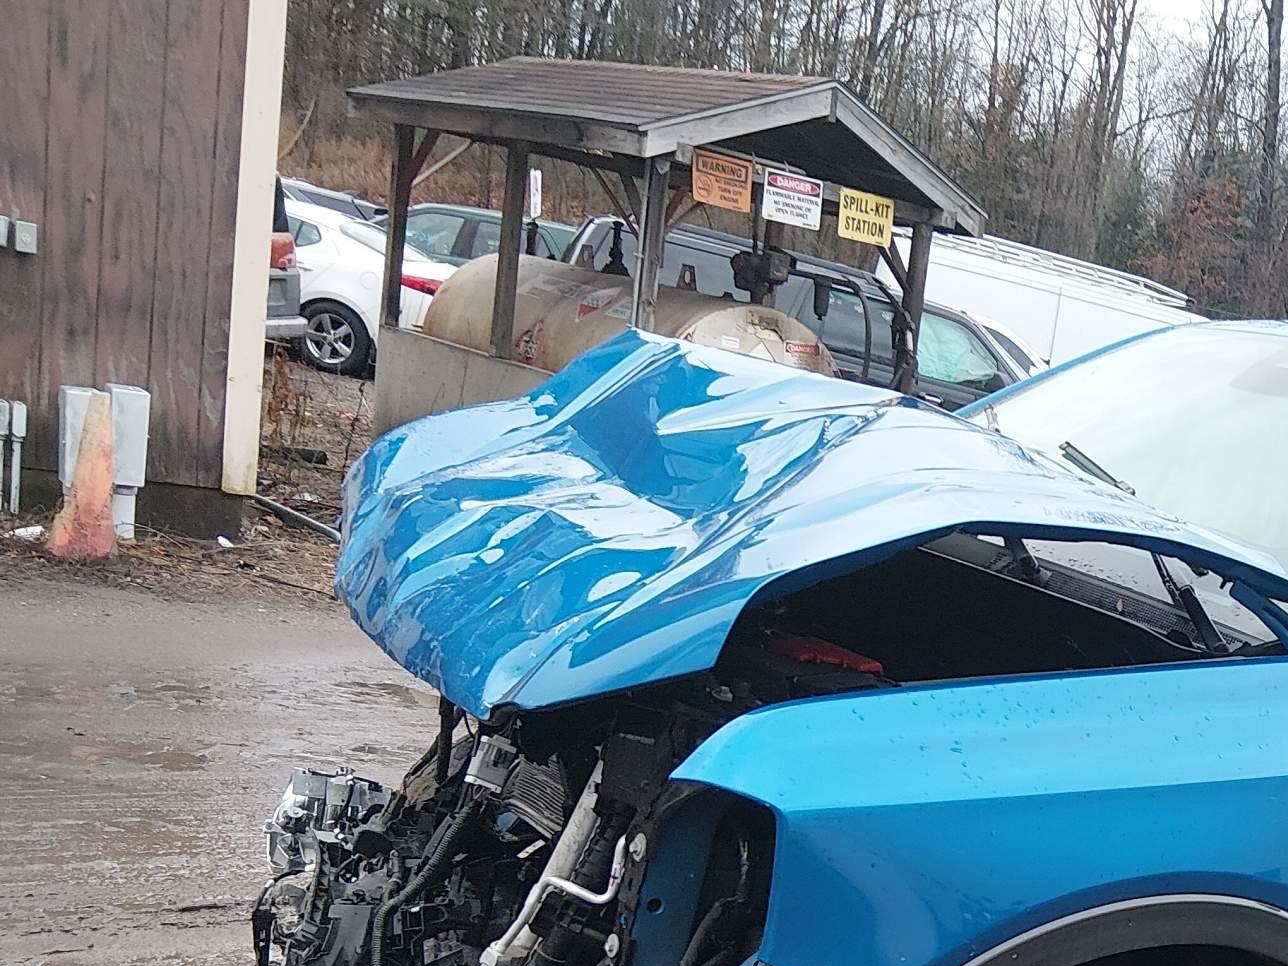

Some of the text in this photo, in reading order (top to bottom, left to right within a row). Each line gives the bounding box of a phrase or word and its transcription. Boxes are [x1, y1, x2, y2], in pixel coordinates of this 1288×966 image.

[700, 158, 743, 179] WARNING
[776, 176, 812, 193] DANGER
[843, 194, 890, 219] SPILL-KIT
[845, 215, 885, 239] STATION
